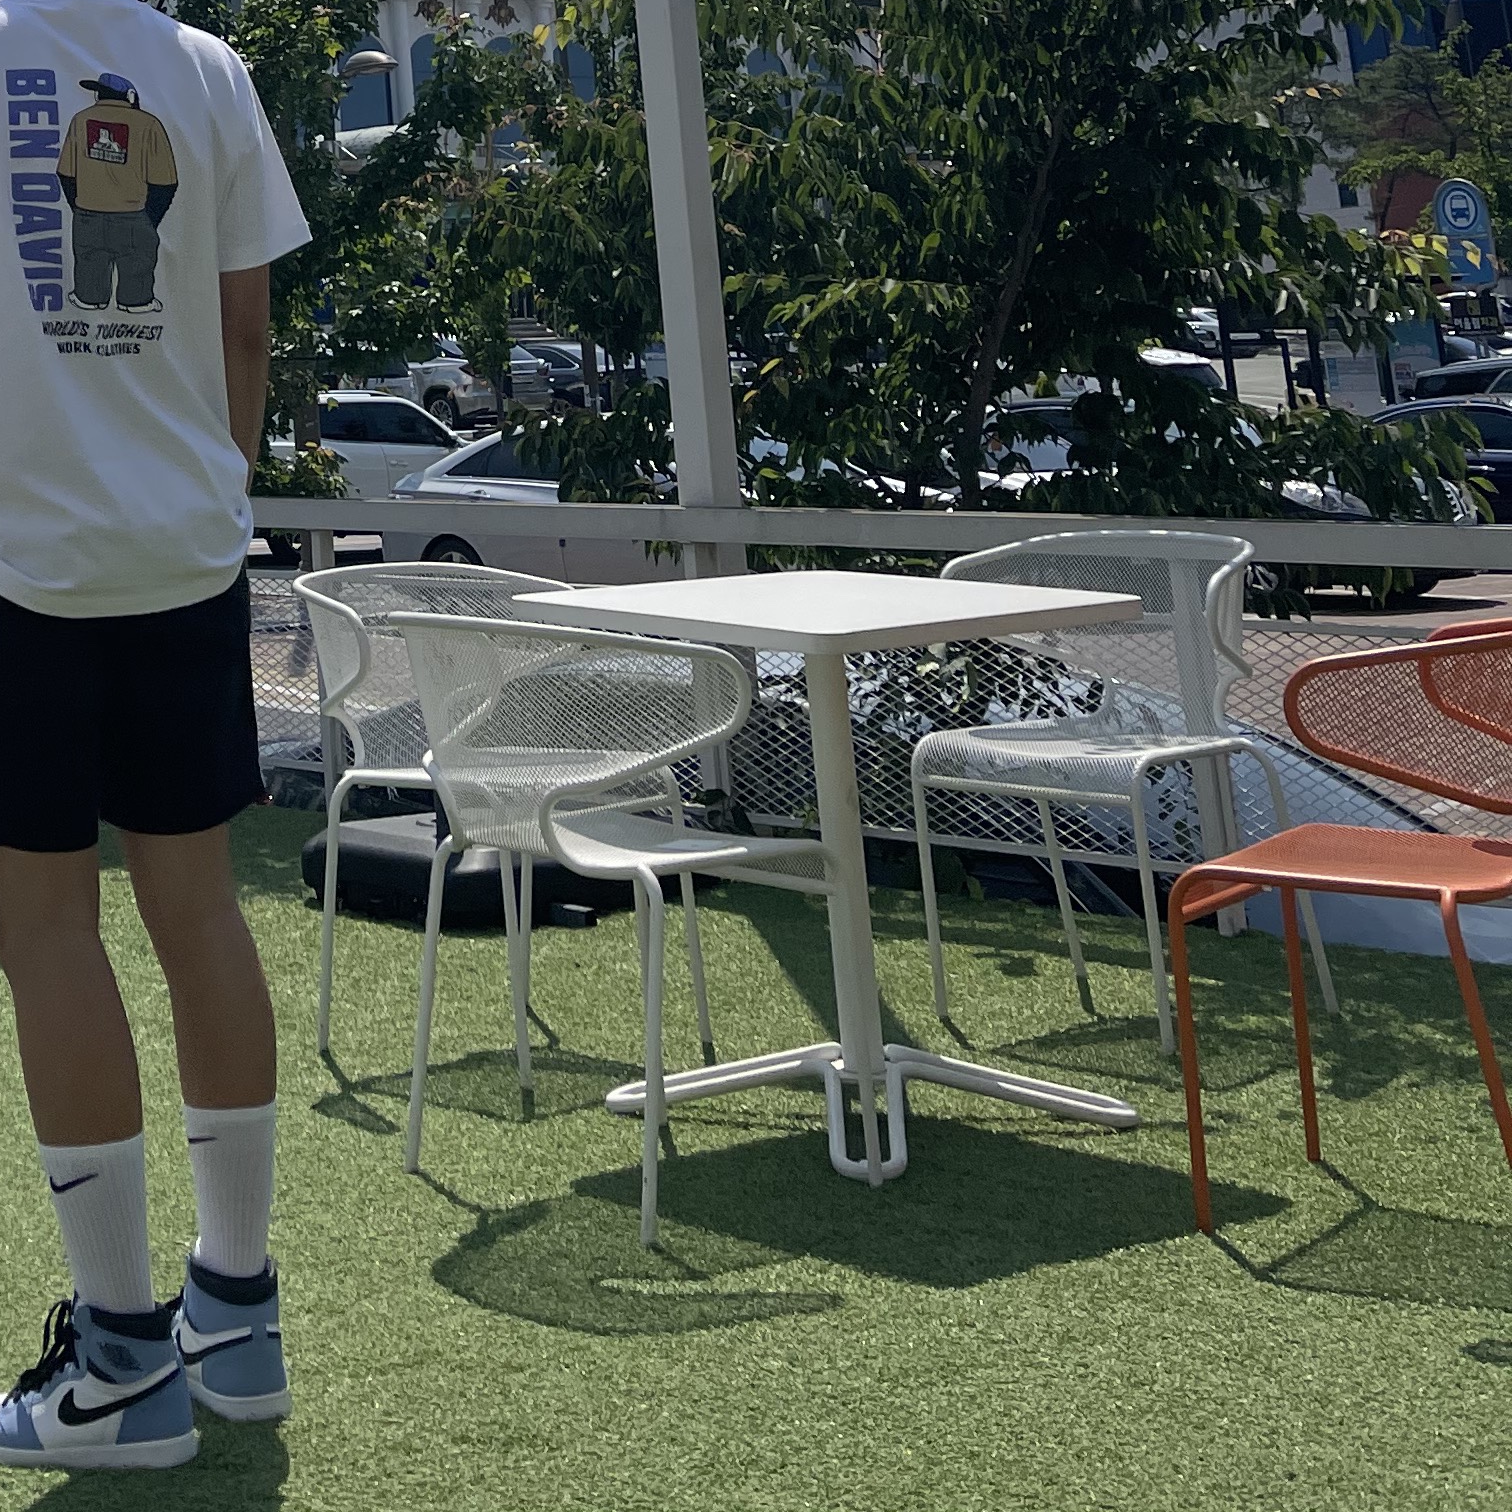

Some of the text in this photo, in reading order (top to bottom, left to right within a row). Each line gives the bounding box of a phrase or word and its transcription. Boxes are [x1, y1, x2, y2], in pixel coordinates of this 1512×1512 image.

[5, 68, 64, 313] BEN DAVIS
[41, 320, 164, 342] WORLD'S TOUGHEST
[56, 341, 93, 355] WORK
